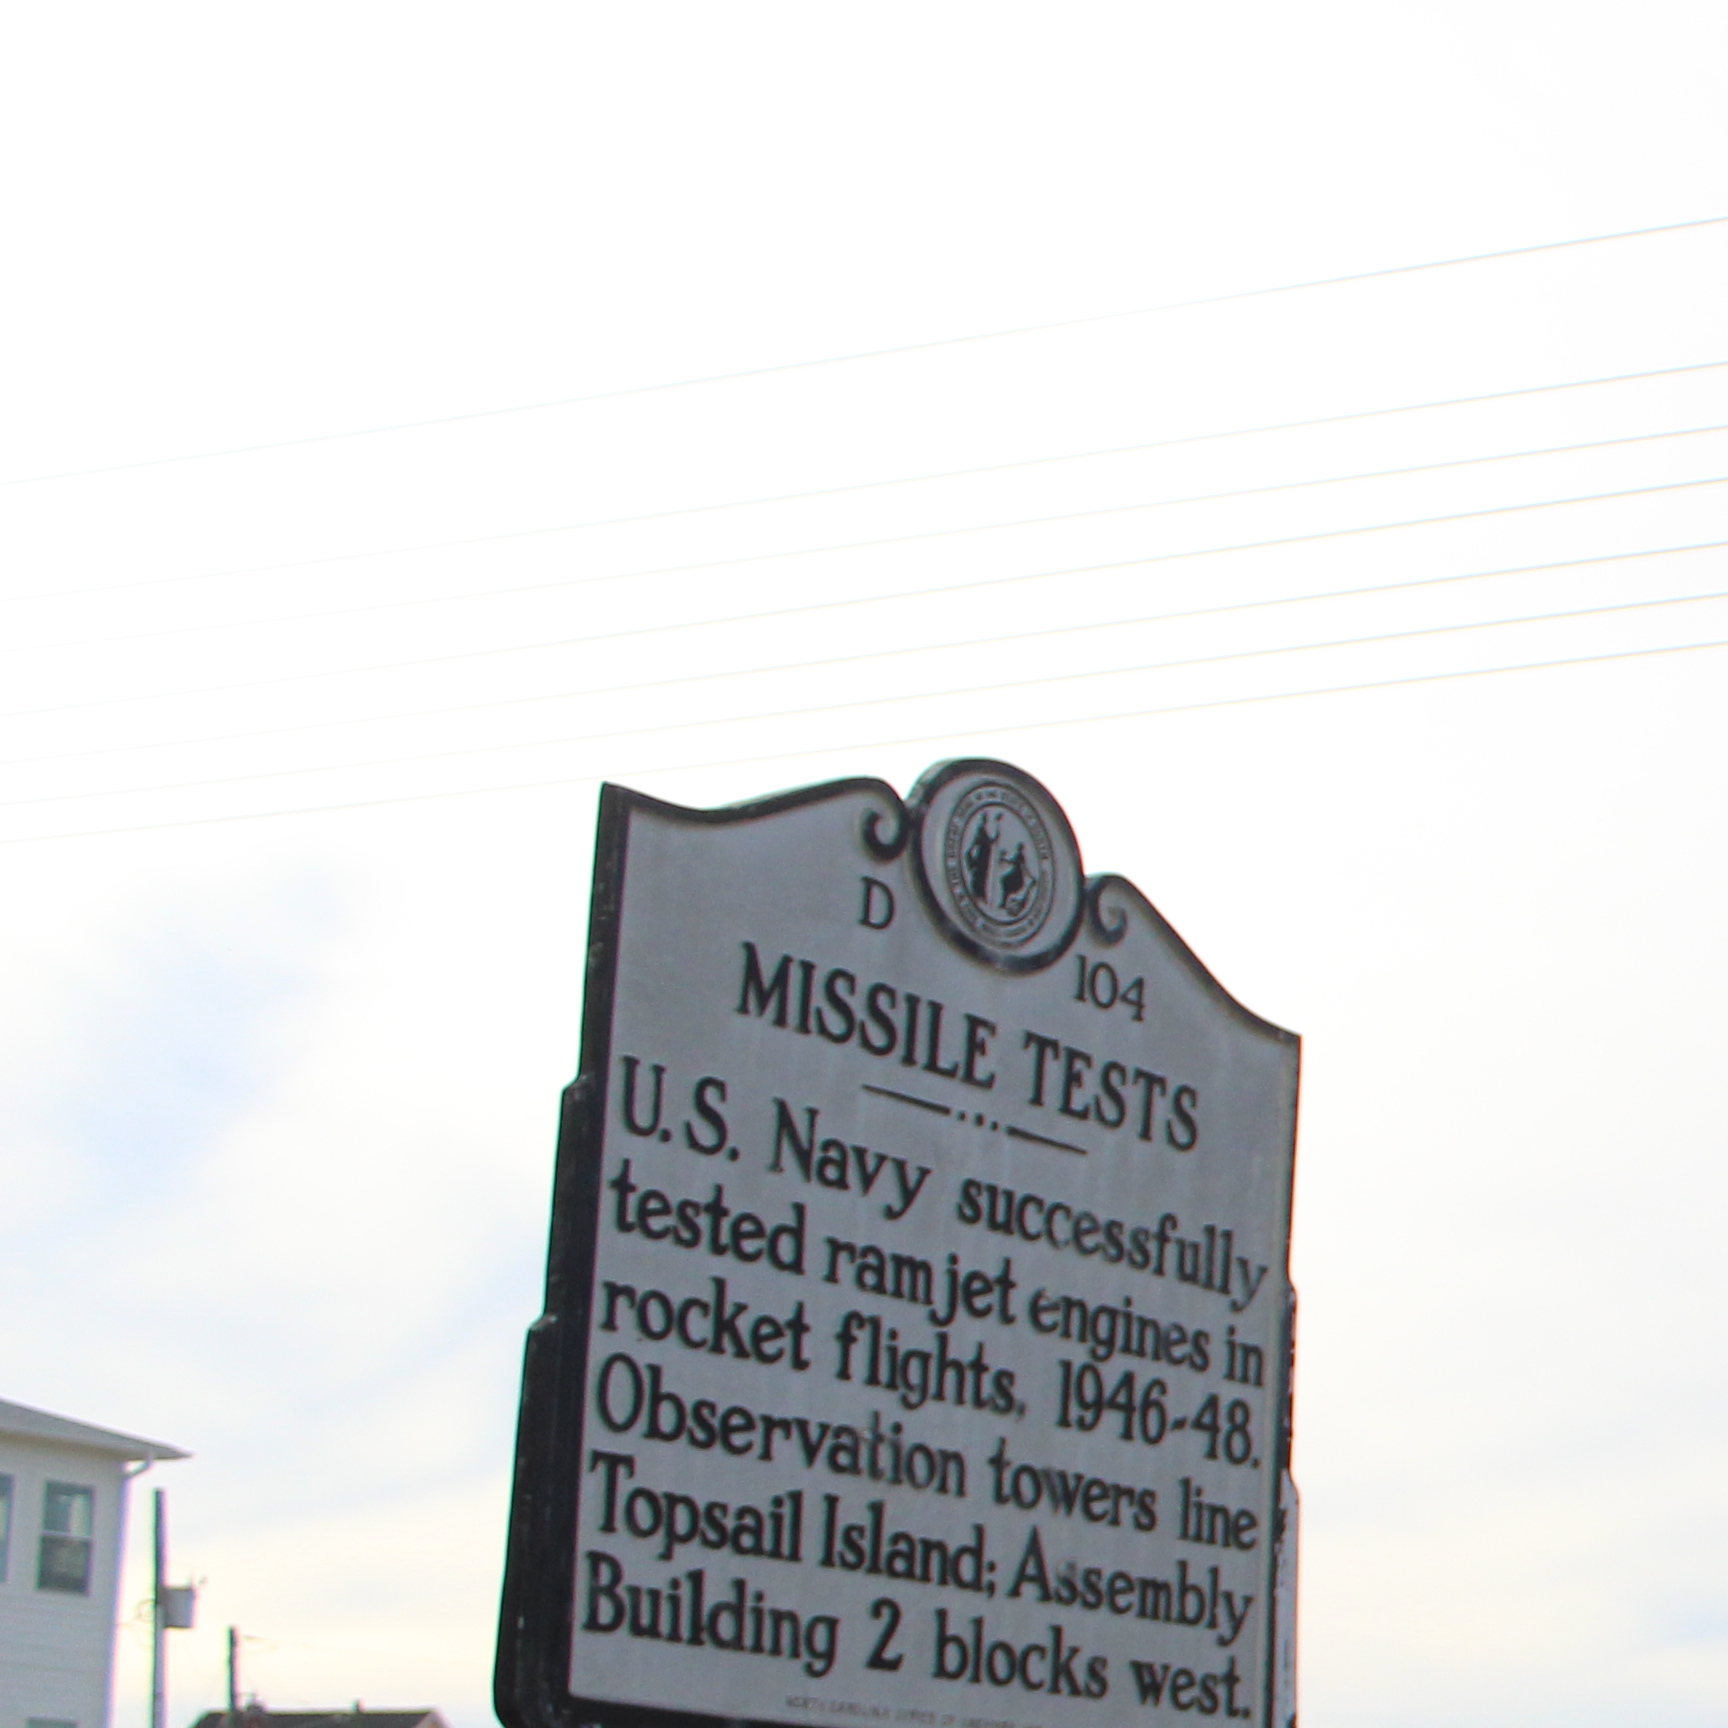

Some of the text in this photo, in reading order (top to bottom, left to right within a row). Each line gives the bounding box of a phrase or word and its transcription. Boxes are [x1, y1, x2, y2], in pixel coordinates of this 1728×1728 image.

[860, 876, 895, 931] D
[1073, 954, 1146, 1023] 104
[736, 941, 1199, 1153] MISSILE TESTS
[608, 1158, 1264, 1388] tested ramjet engines in
[620, 1054, 1269, 1313] U.S. Navy successfully
[598, 1351, 1259, 1551] Observation towers line
[600, 1276, 812, 1371] rocket
[1057, 1359, 1261, 1469] 1946-48.
[582, 1549, 1252, 1720] Building 2 blocks west.
[588, 1448, 1255, 1647] Topsail Island; Assembly
